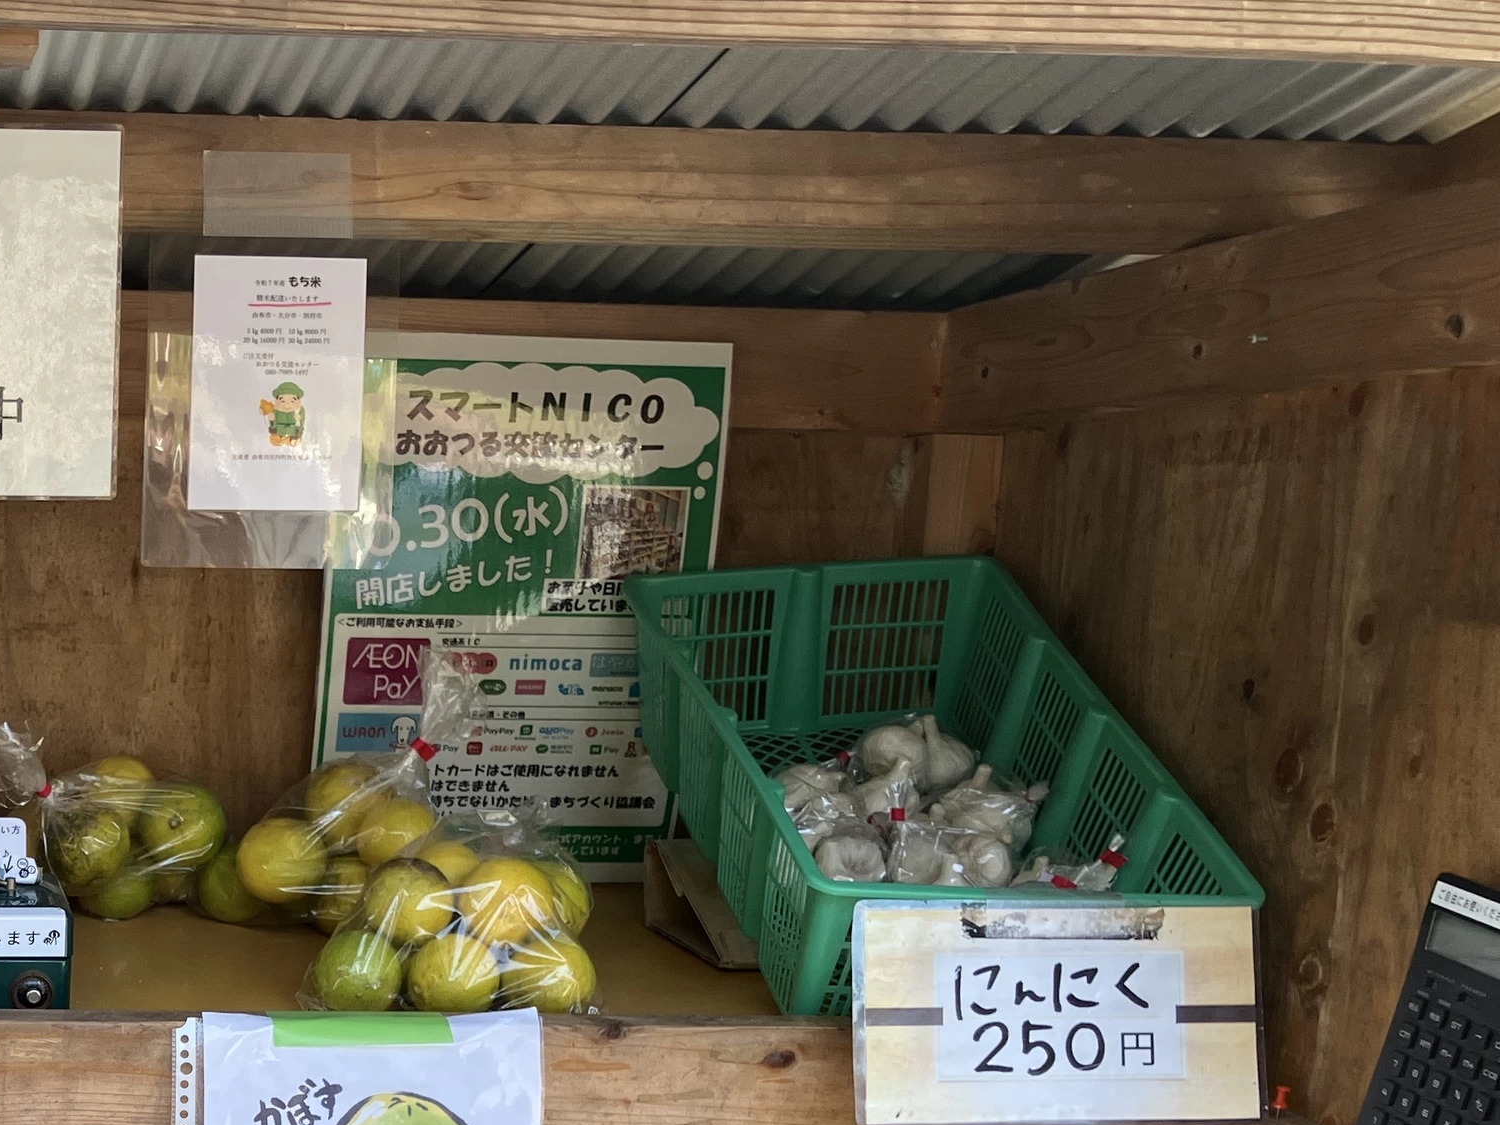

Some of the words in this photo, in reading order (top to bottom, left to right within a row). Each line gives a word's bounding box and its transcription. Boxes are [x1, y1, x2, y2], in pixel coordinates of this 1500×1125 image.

[288, 276, 321, 288] もち米
[546, 598, 633, 612] 販売していま
[509, 653, 583, 671] nimoca
[955, 961, 1150, 1021] にんにく
